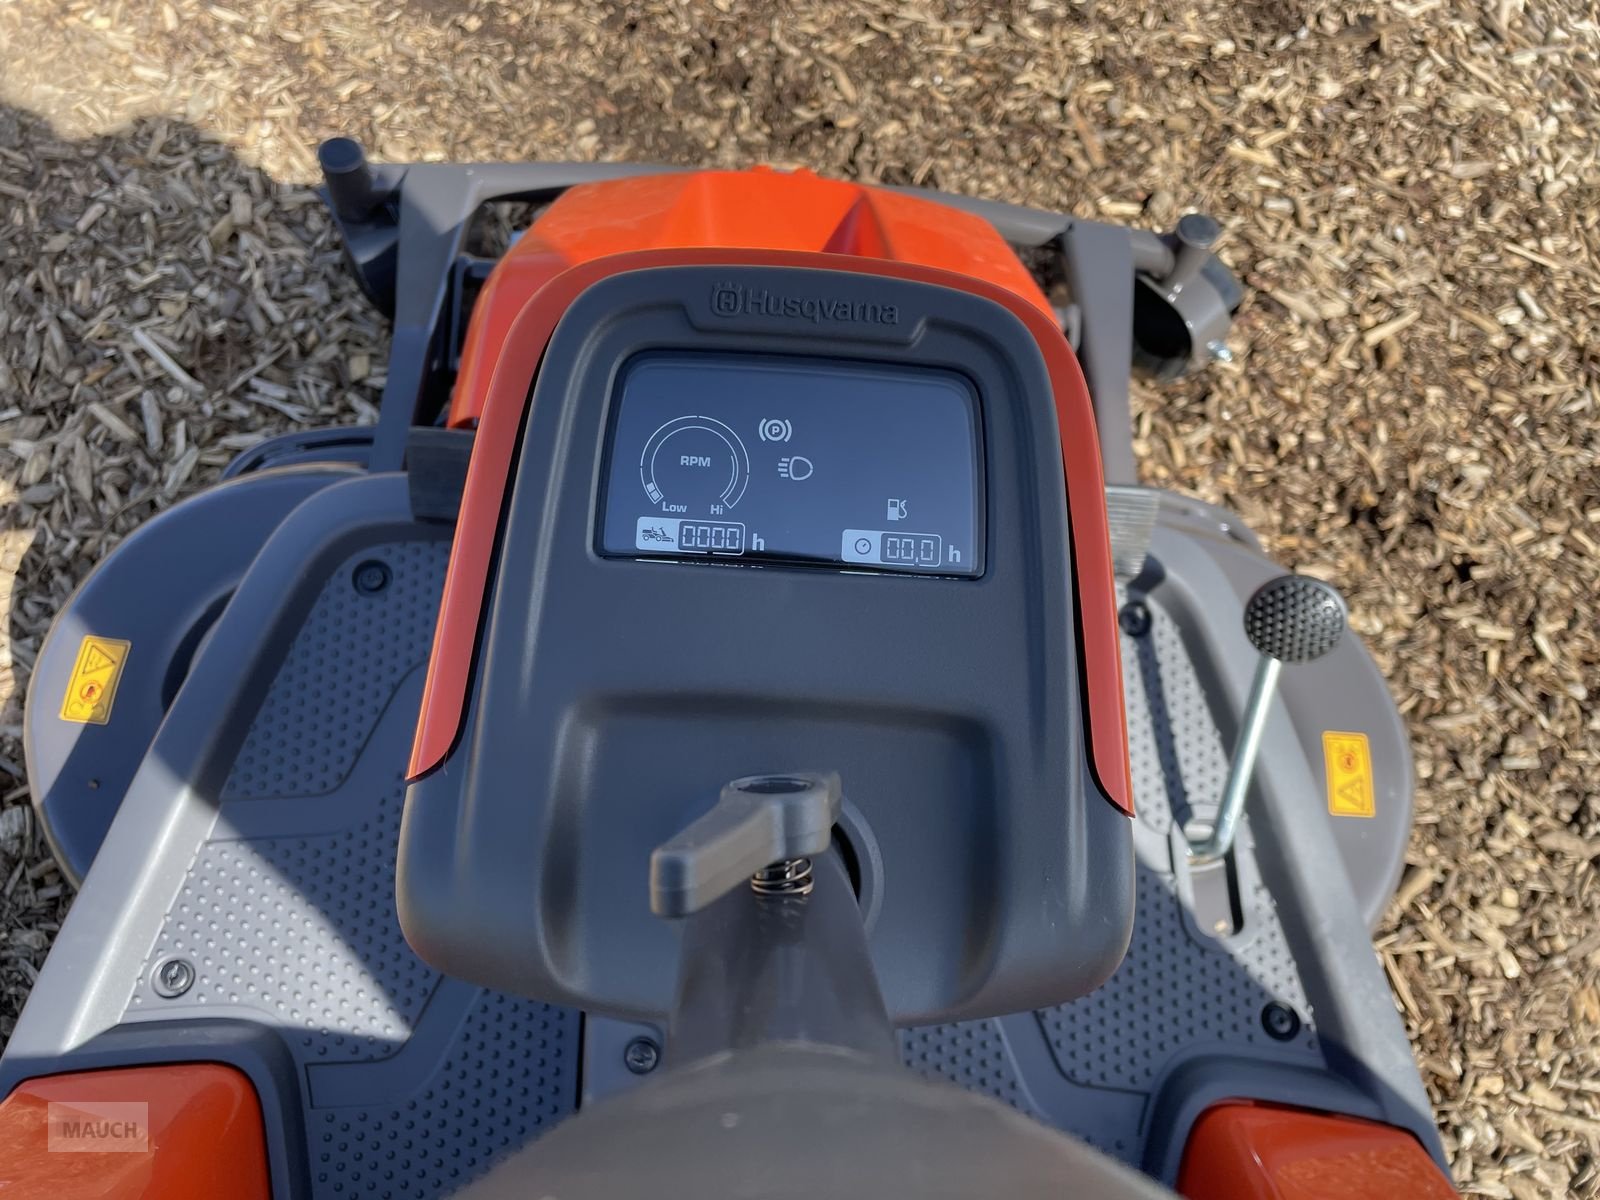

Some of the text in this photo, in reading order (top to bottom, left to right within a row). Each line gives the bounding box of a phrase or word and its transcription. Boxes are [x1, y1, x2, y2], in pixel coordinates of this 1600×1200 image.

[744, 289, 899, 325] Husqvarna
[680, 455, 711, 467] RPM
[662, 501, 688, 513] Low
[710, 504, 724, 515] Hi
[682, 525, 765, 551] 0000 h
[948, 544, 961, 563] h
